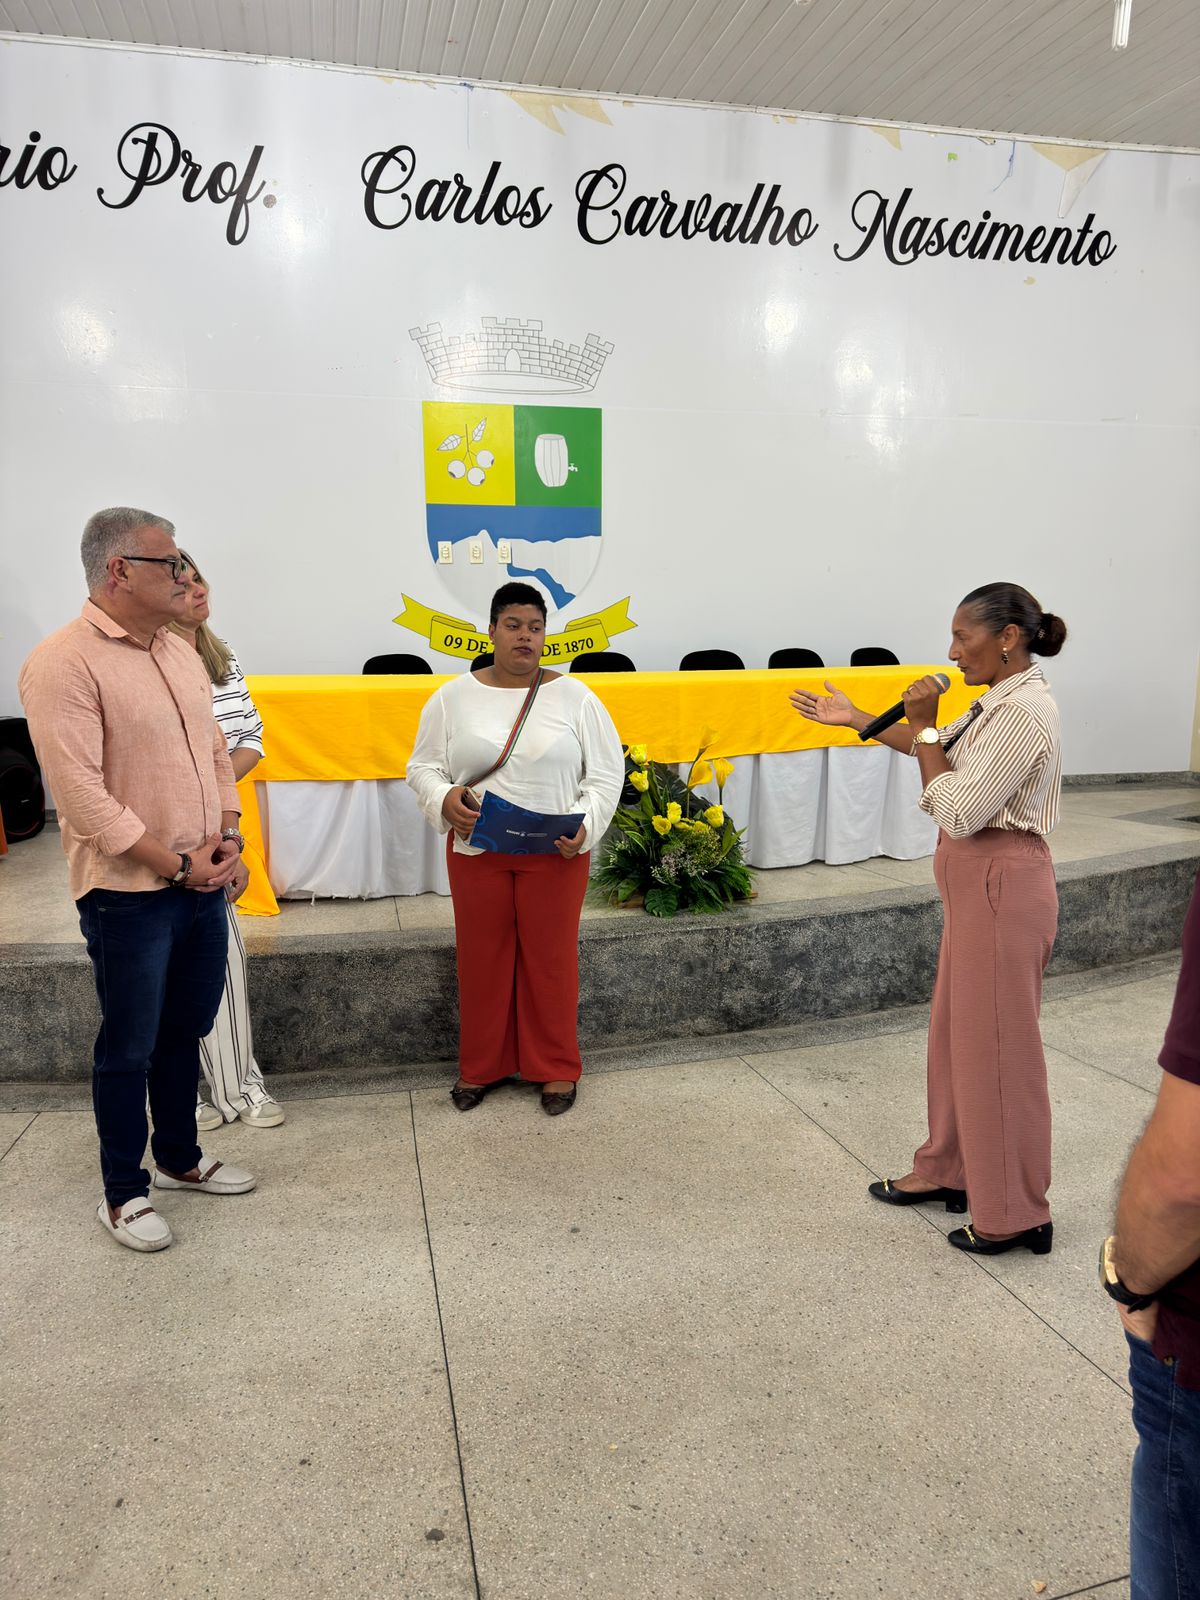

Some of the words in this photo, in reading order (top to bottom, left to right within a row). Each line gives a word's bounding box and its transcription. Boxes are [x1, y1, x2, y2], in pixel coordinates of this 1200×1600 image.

[97, 123, 278, 246] Prof.
[361, 145, 552, 229] Carlos
[576, 163, 818, 247] Carvalho
[834, 187, 1117, 266] Nascimento
[443, 634, 463, 649] 09
[466, 638, 489, 654] DE
[541, 641, 562, 657] DE
[564, 637, 594, 654] 1870
